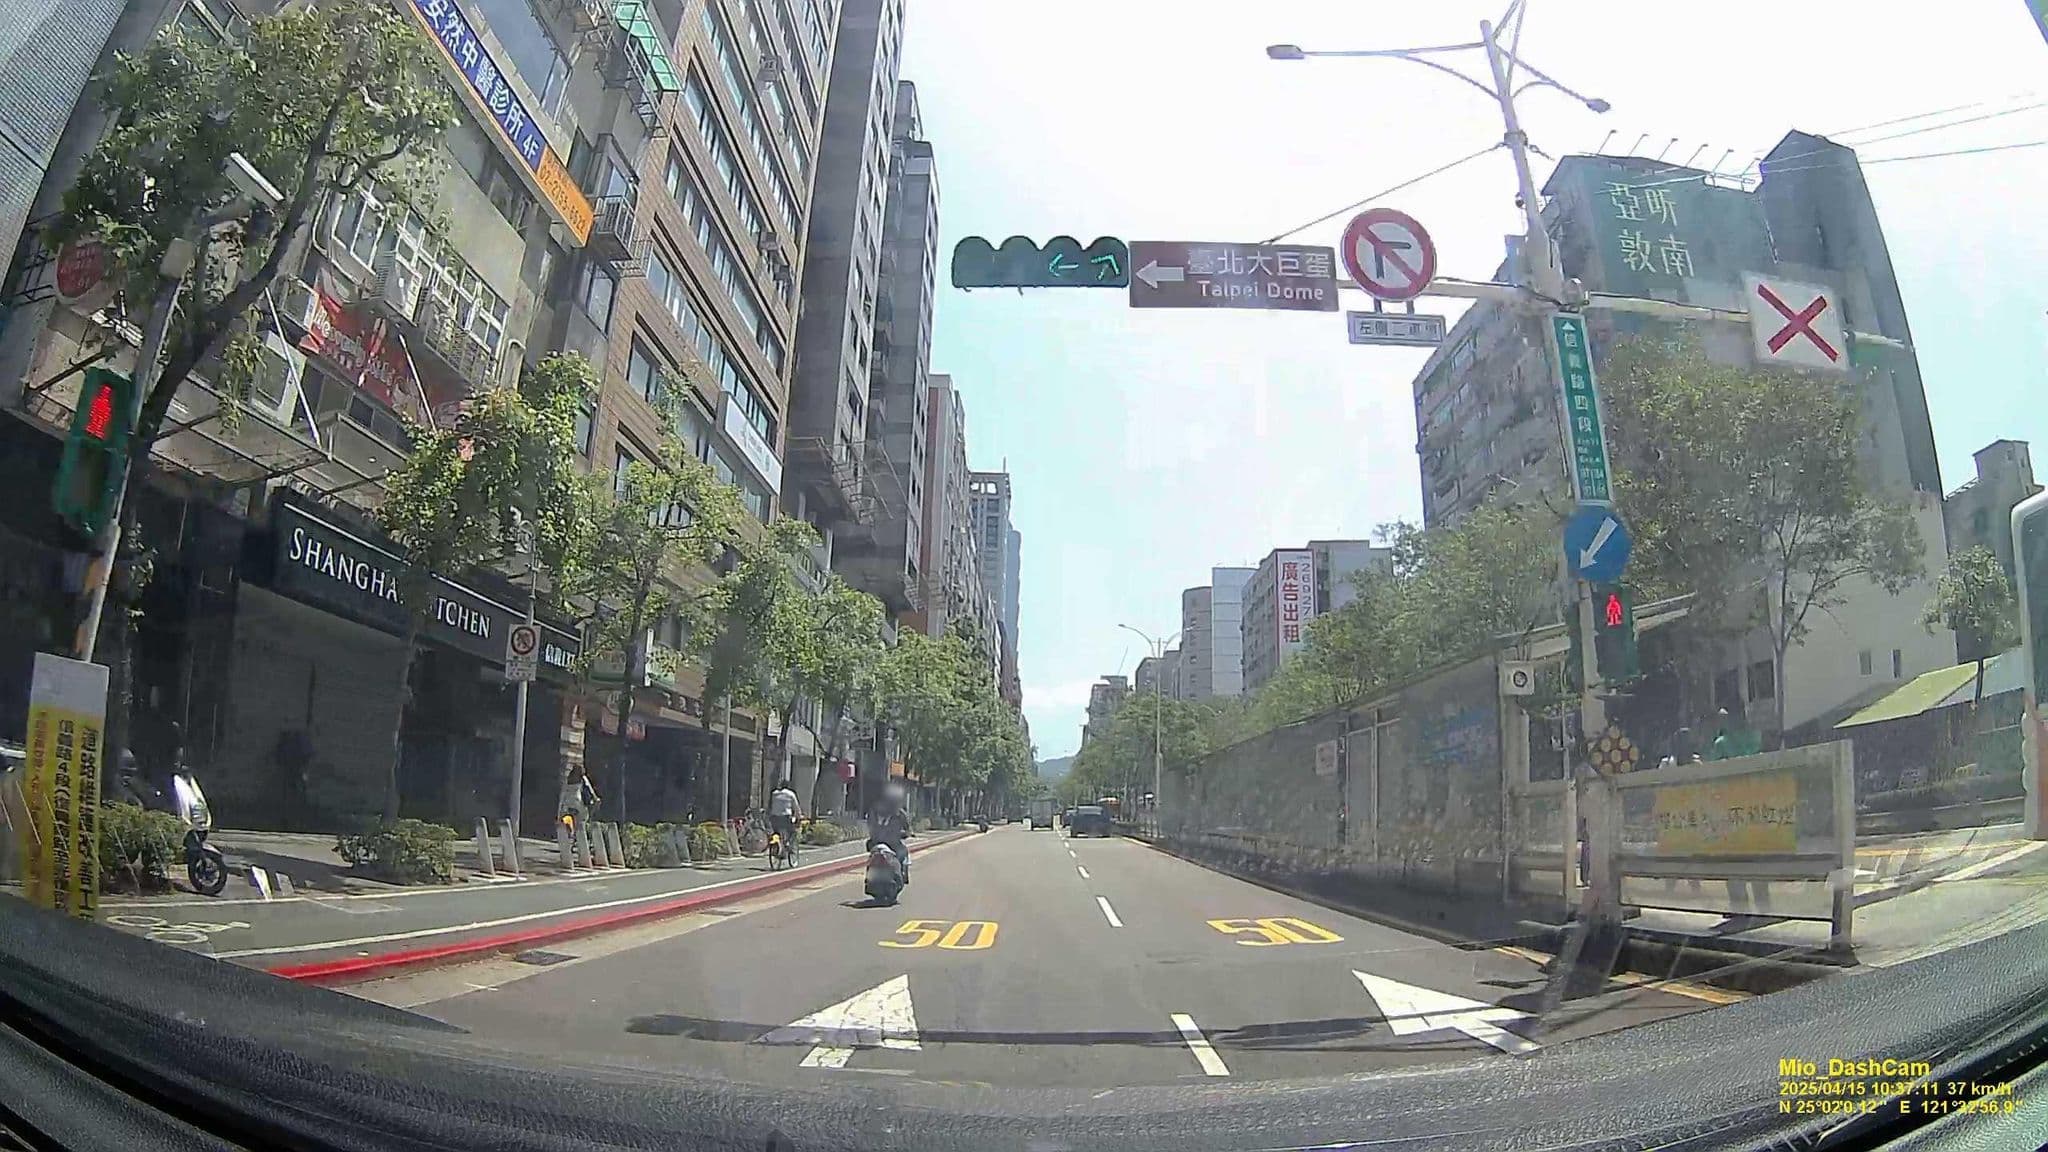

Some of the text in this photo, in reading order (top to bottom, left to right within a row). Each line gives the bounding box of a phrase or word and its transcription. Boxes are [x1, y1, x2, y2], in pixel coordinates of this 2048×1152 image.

[421, 0, 540, 160] 安然中醫診所 4F
[1608, 182, 1680, 227] 亞昕
[1617, 227, 1695, 278] 敦南
[1197, 279, 1324, 302] Taipei Dome
[288, 527, 491, 640] SHANGHA TCHEN
[1281, 561, 1301, 643] 廣告出租
[1301, 562, 1314, 622] 26927
[879, 919, 999, 951] 50
[1206, 917, 1345, 946] 50
